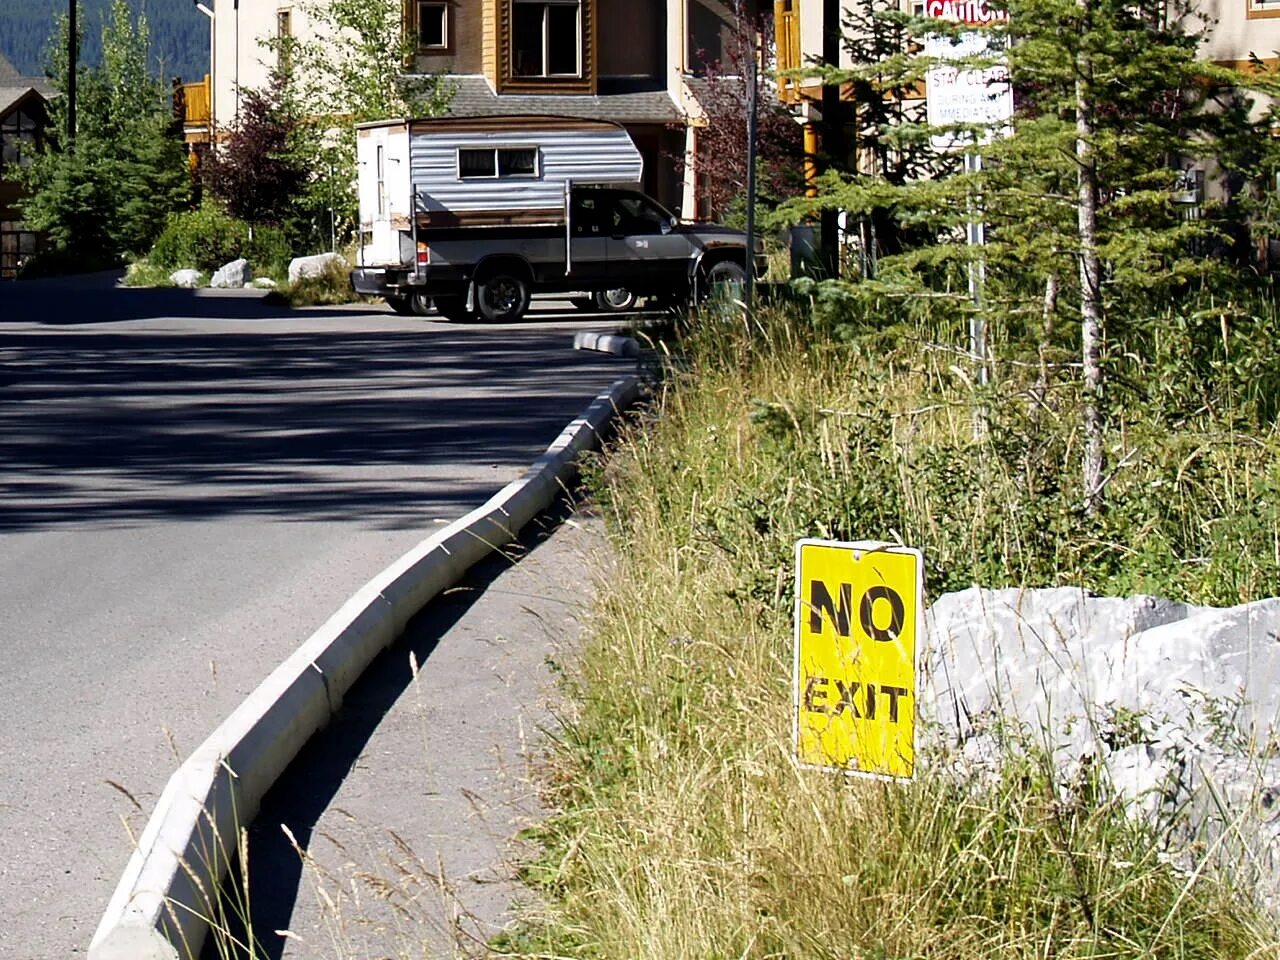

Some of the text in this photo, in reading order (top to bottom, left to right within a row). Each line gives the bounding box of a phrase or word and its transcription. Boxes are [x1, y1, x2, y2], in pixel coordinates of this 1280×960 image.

[933, 69, 1004, 87] STAY CLEAR
[937, 93, 976, 105] DURING
[810, 579, 905, 642] NO
[806, 675, 908, 723] EXIT
